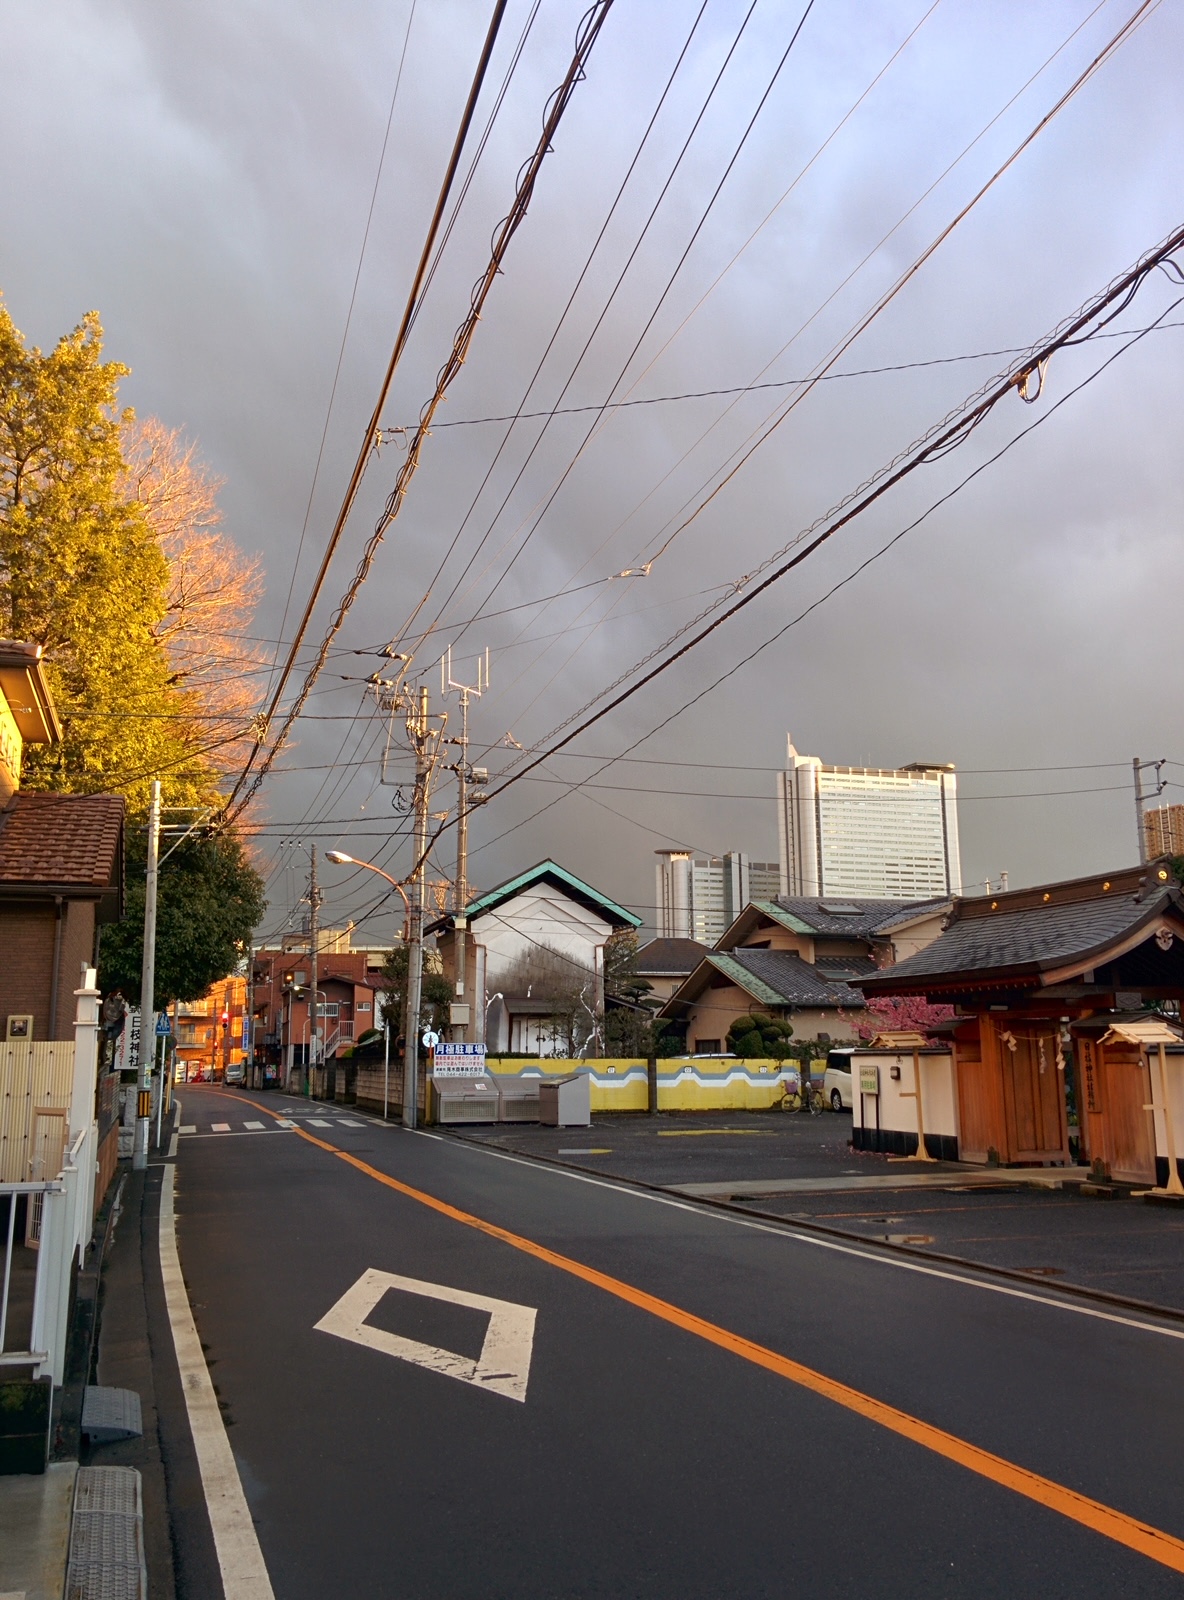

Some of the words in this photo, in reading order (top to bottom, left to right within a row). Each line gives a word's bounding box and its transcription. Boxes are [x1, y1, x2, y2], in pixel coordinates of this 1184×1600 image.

[128, 1016, 141, 1066] 日枝神社
[436, 1044, 484, 1054] 月極駐車場
